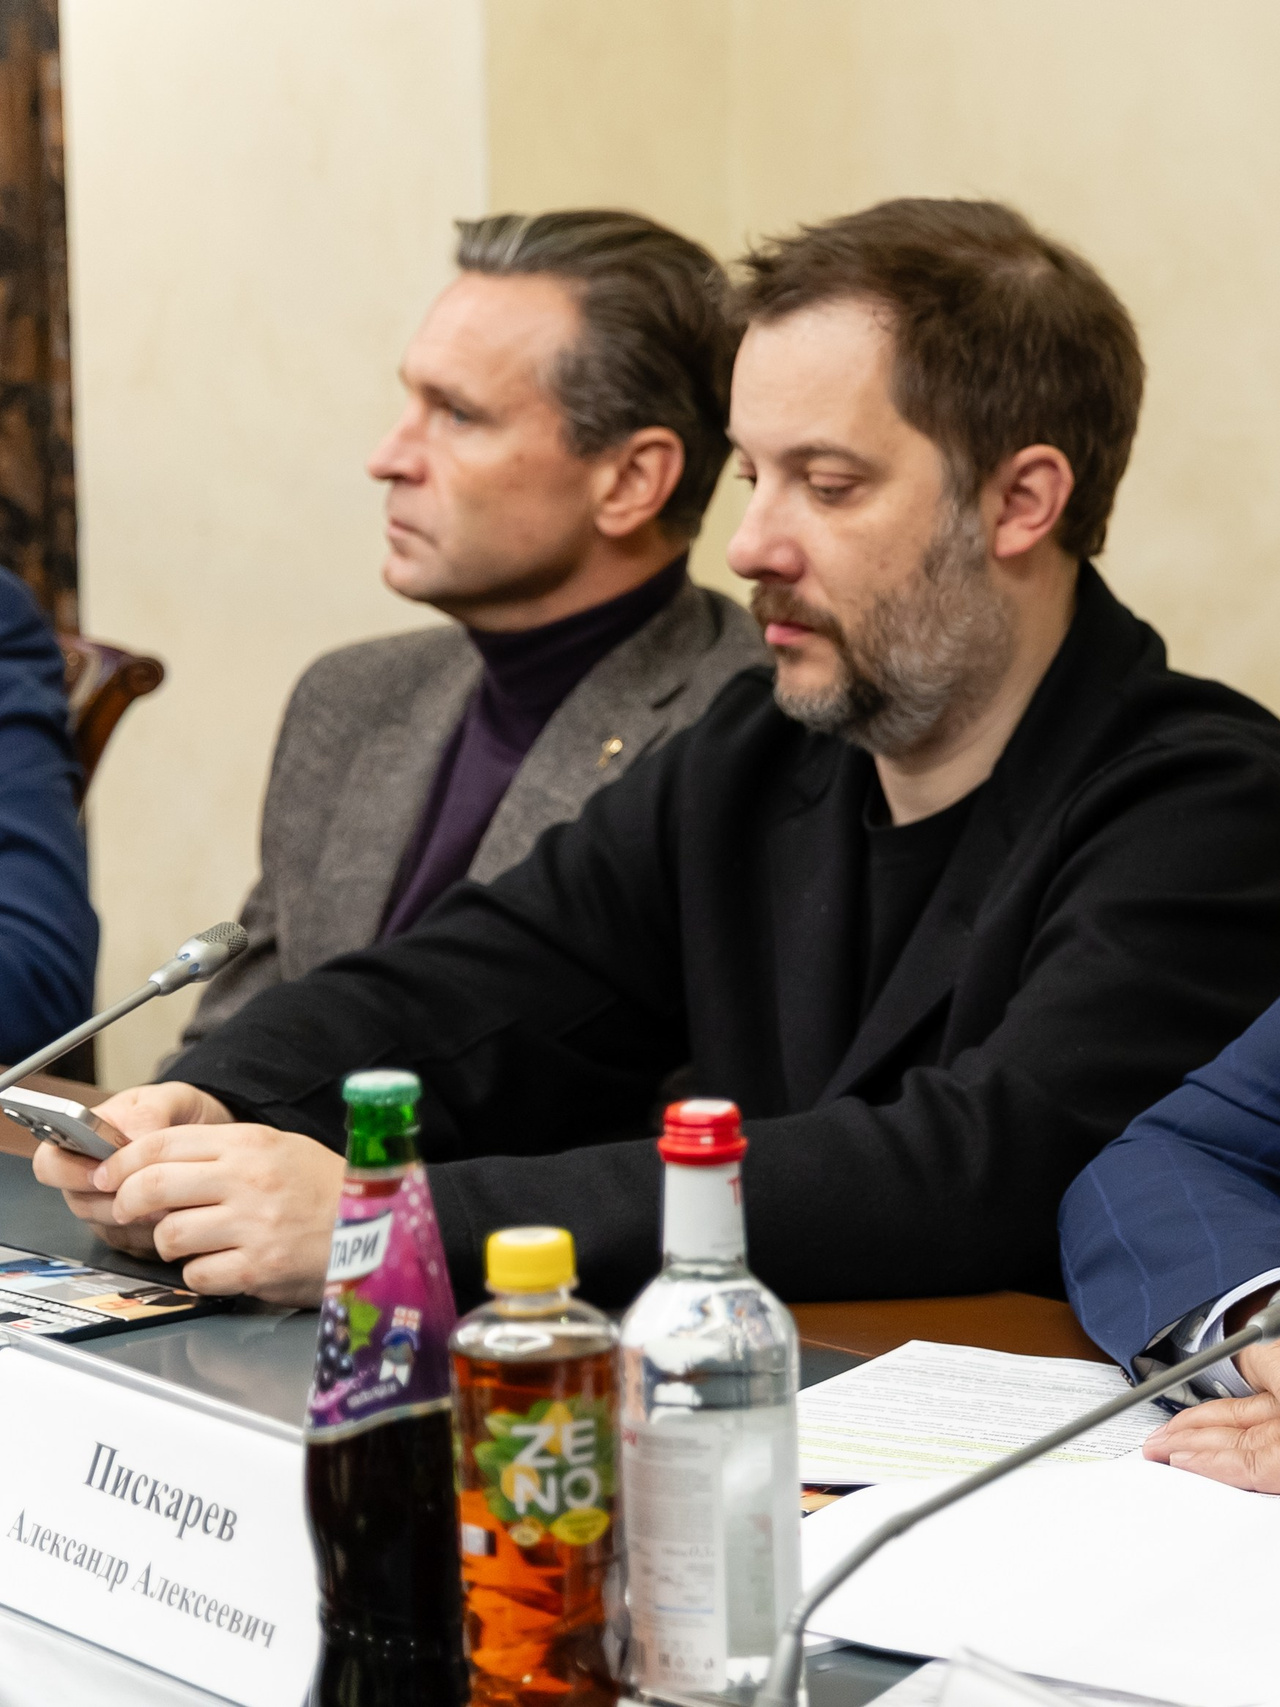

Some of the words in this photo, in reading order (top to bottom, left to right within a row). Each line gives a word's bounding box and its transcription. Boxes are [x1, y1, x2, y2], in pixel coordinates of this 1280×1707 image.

[330, 1230, 380, 1269] ТАРИ
[510, 1418, 595, 1468] ZE
[83, 1441, 238, 1542] Пискарев
[513, 1466, 600, 1515] NO
[6, 1508, 129, 1593] Александр
[131, 1561, 277, 1649] Алексеевич
